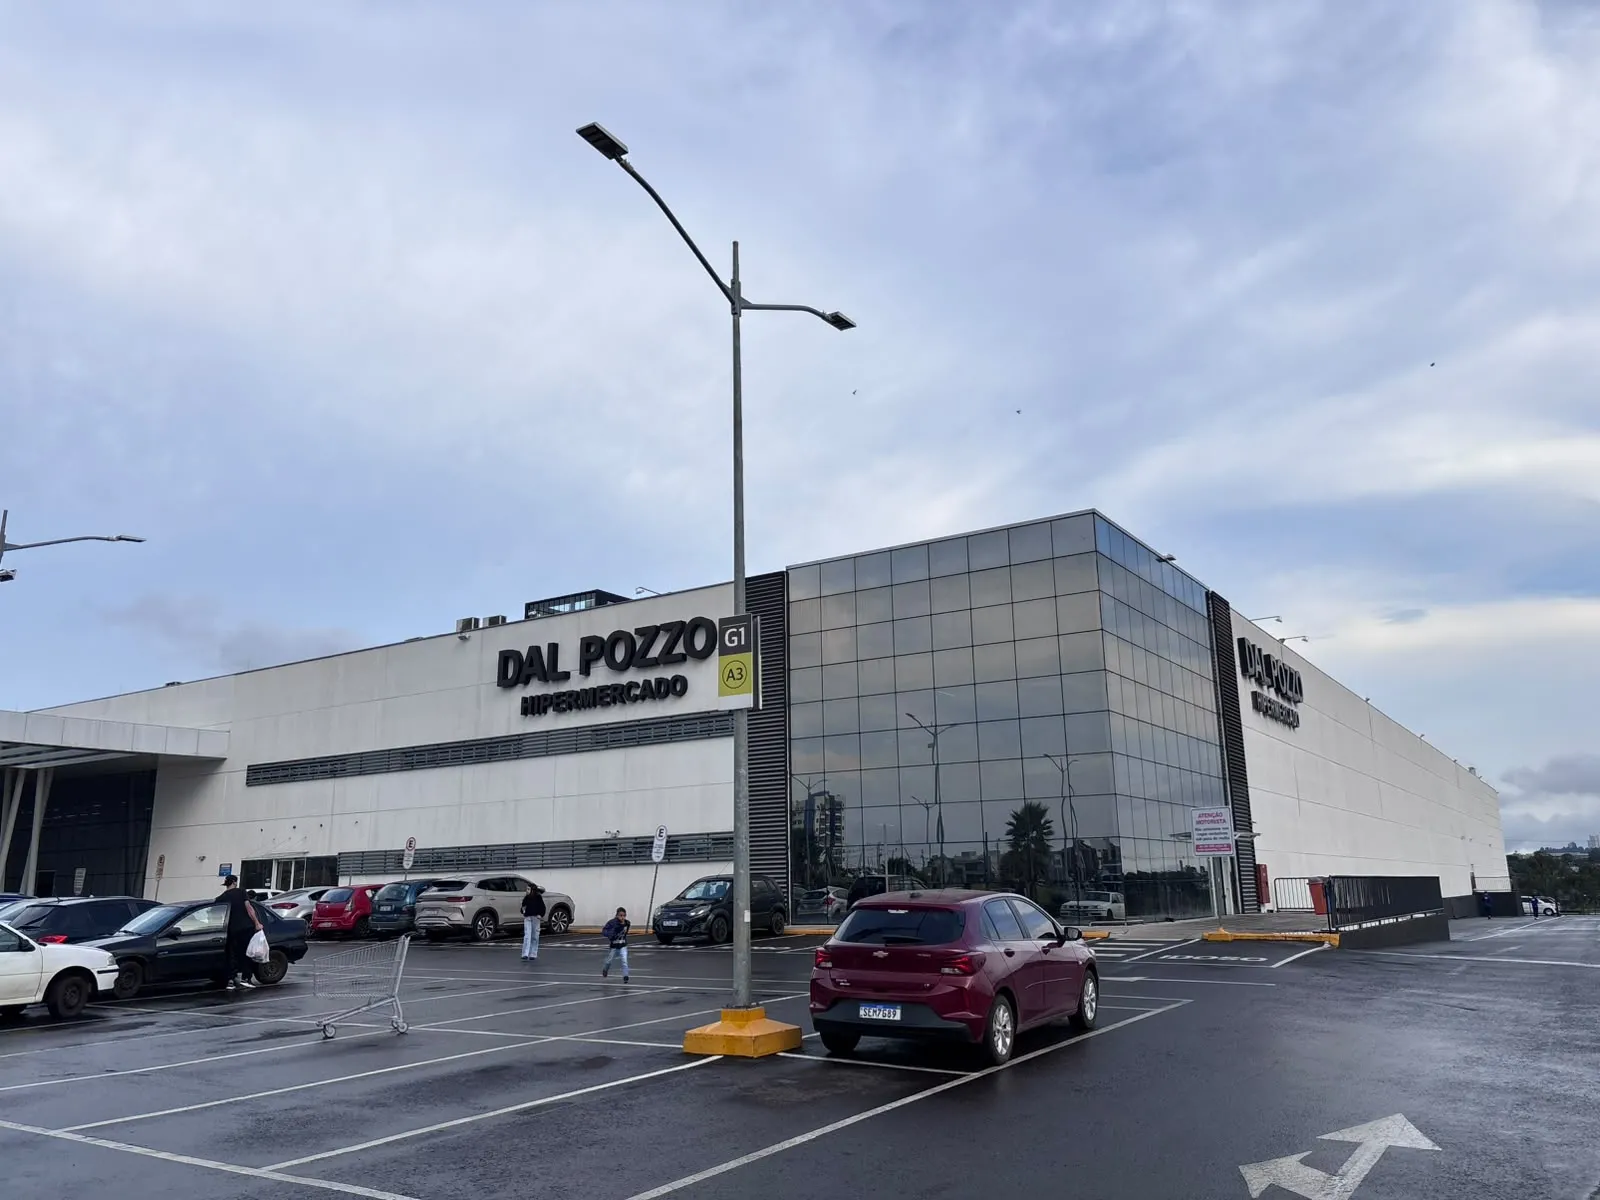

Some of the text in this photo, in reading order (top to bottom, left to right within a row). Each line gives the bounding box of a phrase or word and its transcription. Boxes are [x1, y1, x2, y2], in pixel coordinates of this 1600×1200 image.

[724, 626, 746, 647] G1
[497, 616, 717, 688] DAL POZZO
[726, 667, 744, 682] A3
[521, 675, 688, 716] HIPERMERCADO
[658, 828, 665, 838] E
[408, 840, 414, 848] E
[1158, 954, 1269, 962] IDOSO
